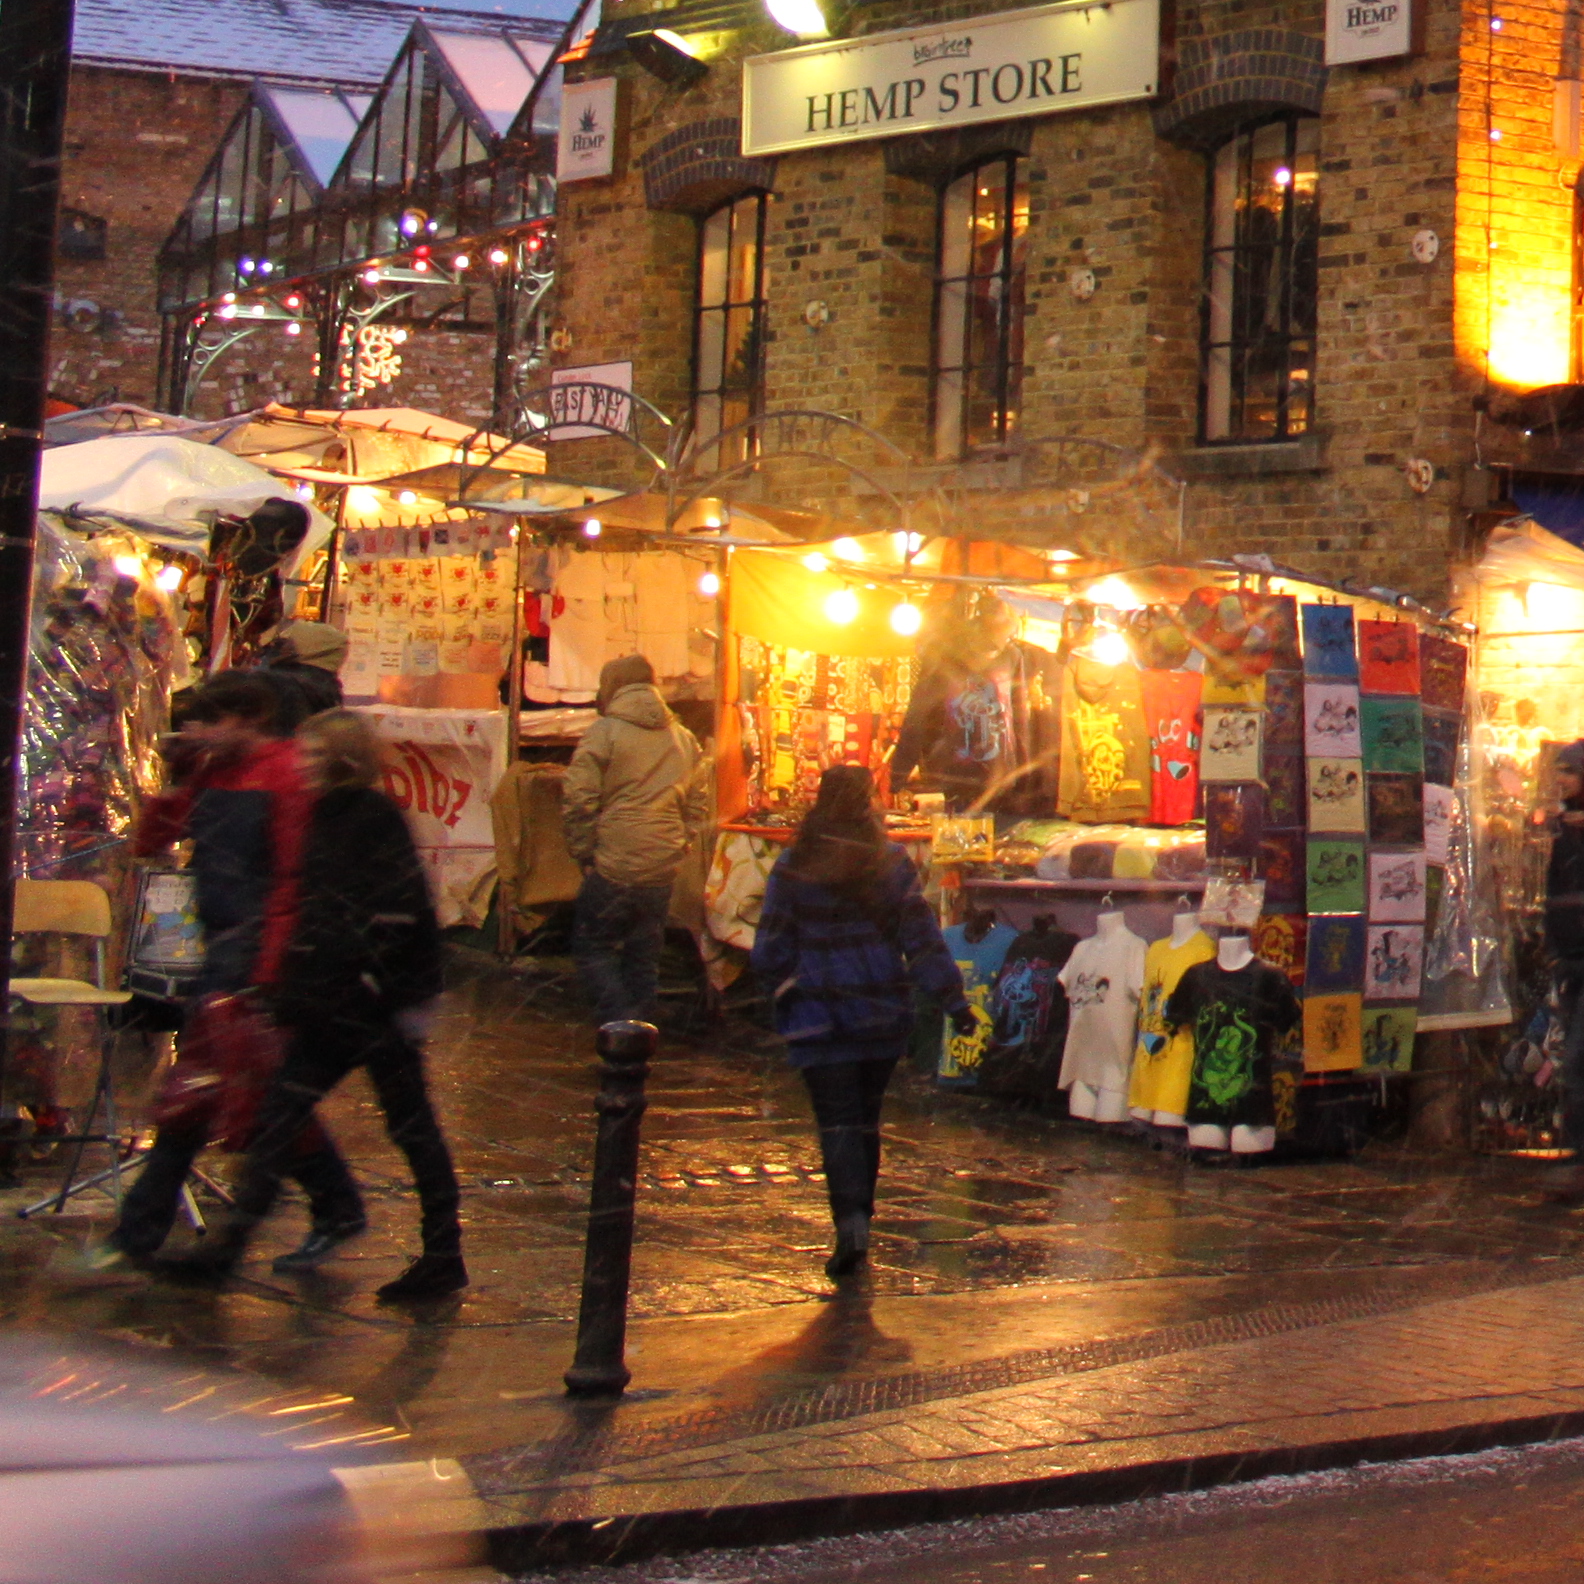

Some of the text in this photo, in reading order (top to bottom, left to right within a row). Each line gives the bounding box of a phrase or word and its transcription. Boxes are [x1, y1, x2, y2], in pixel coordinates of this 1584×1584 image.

[1346, 5, 1397, 28] HEMP
[804, 52, 1083, 133] HEMP STORE
[571, 134, 606, 153] HEMP
